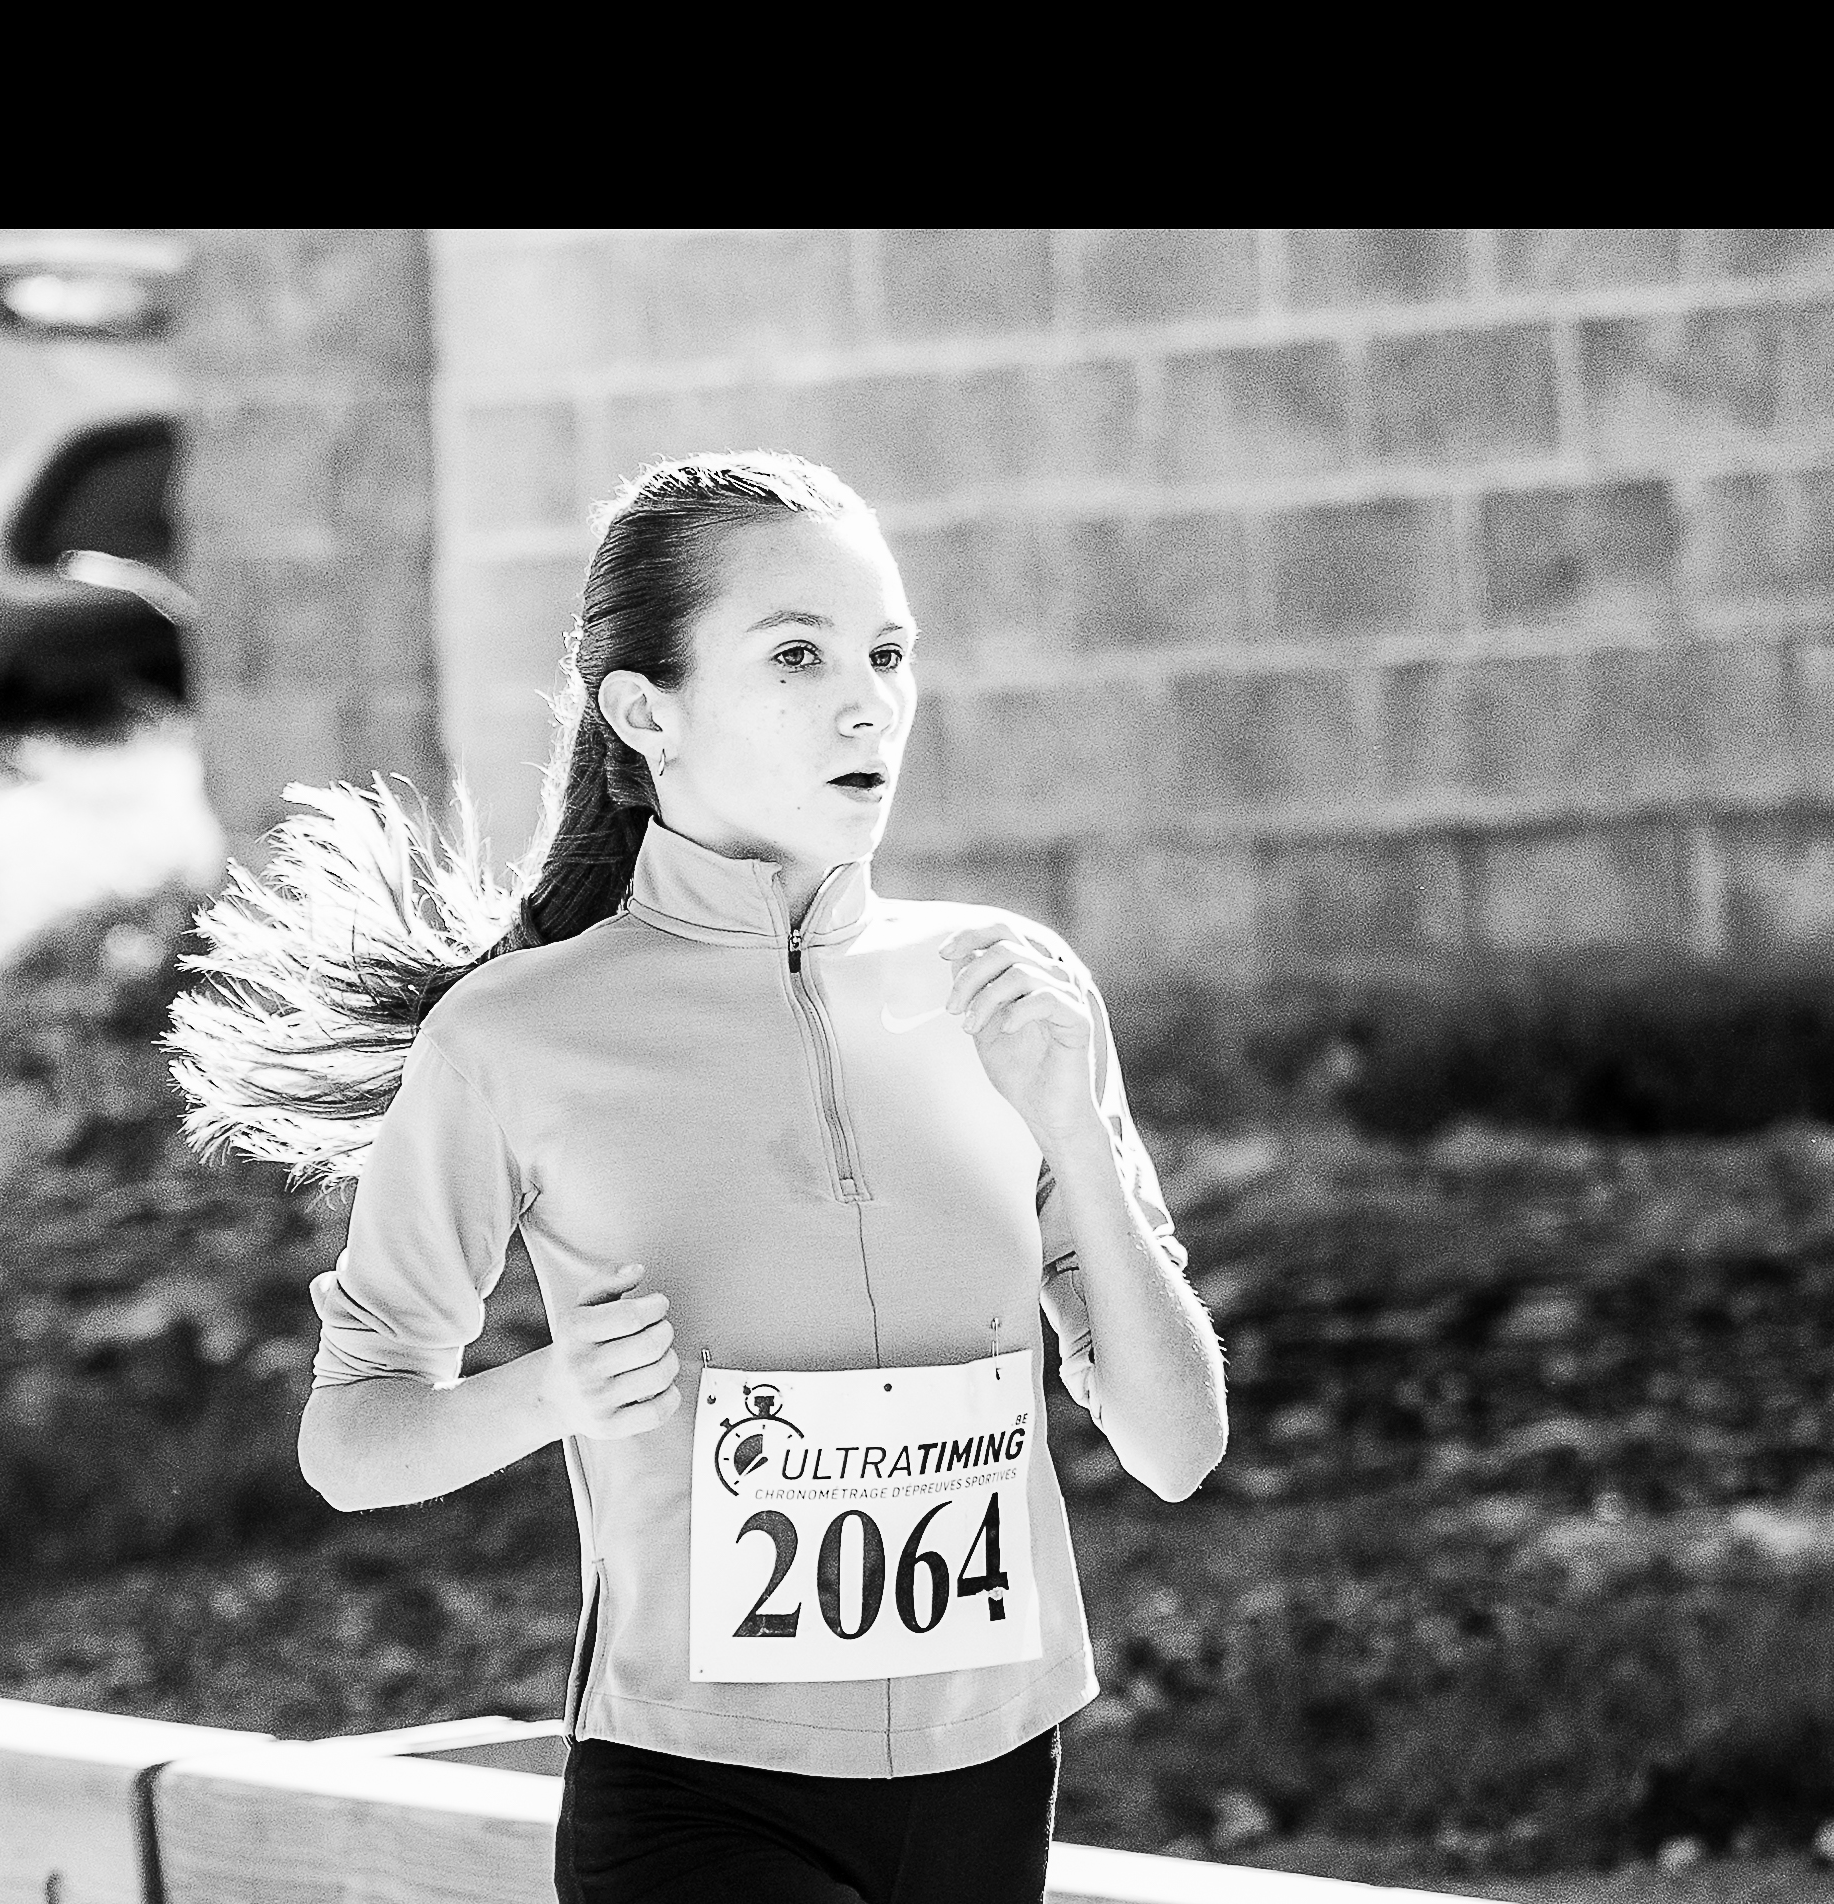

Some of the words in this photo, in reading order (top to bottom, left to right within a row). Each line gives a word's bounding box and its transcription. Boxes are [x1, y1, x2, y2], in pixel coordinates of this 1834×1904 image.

[781, 1428, 1025, 1480] ULTRATIMING
[755, 1486, 887, 1500] CHRONOMÉTRAGE
[891, 1477, 962, 1499] D'ÉPREUVES
[965, 1467, 1017, 1489] SPORTIVES
[732, 1492, 1009, 1639] 2064
